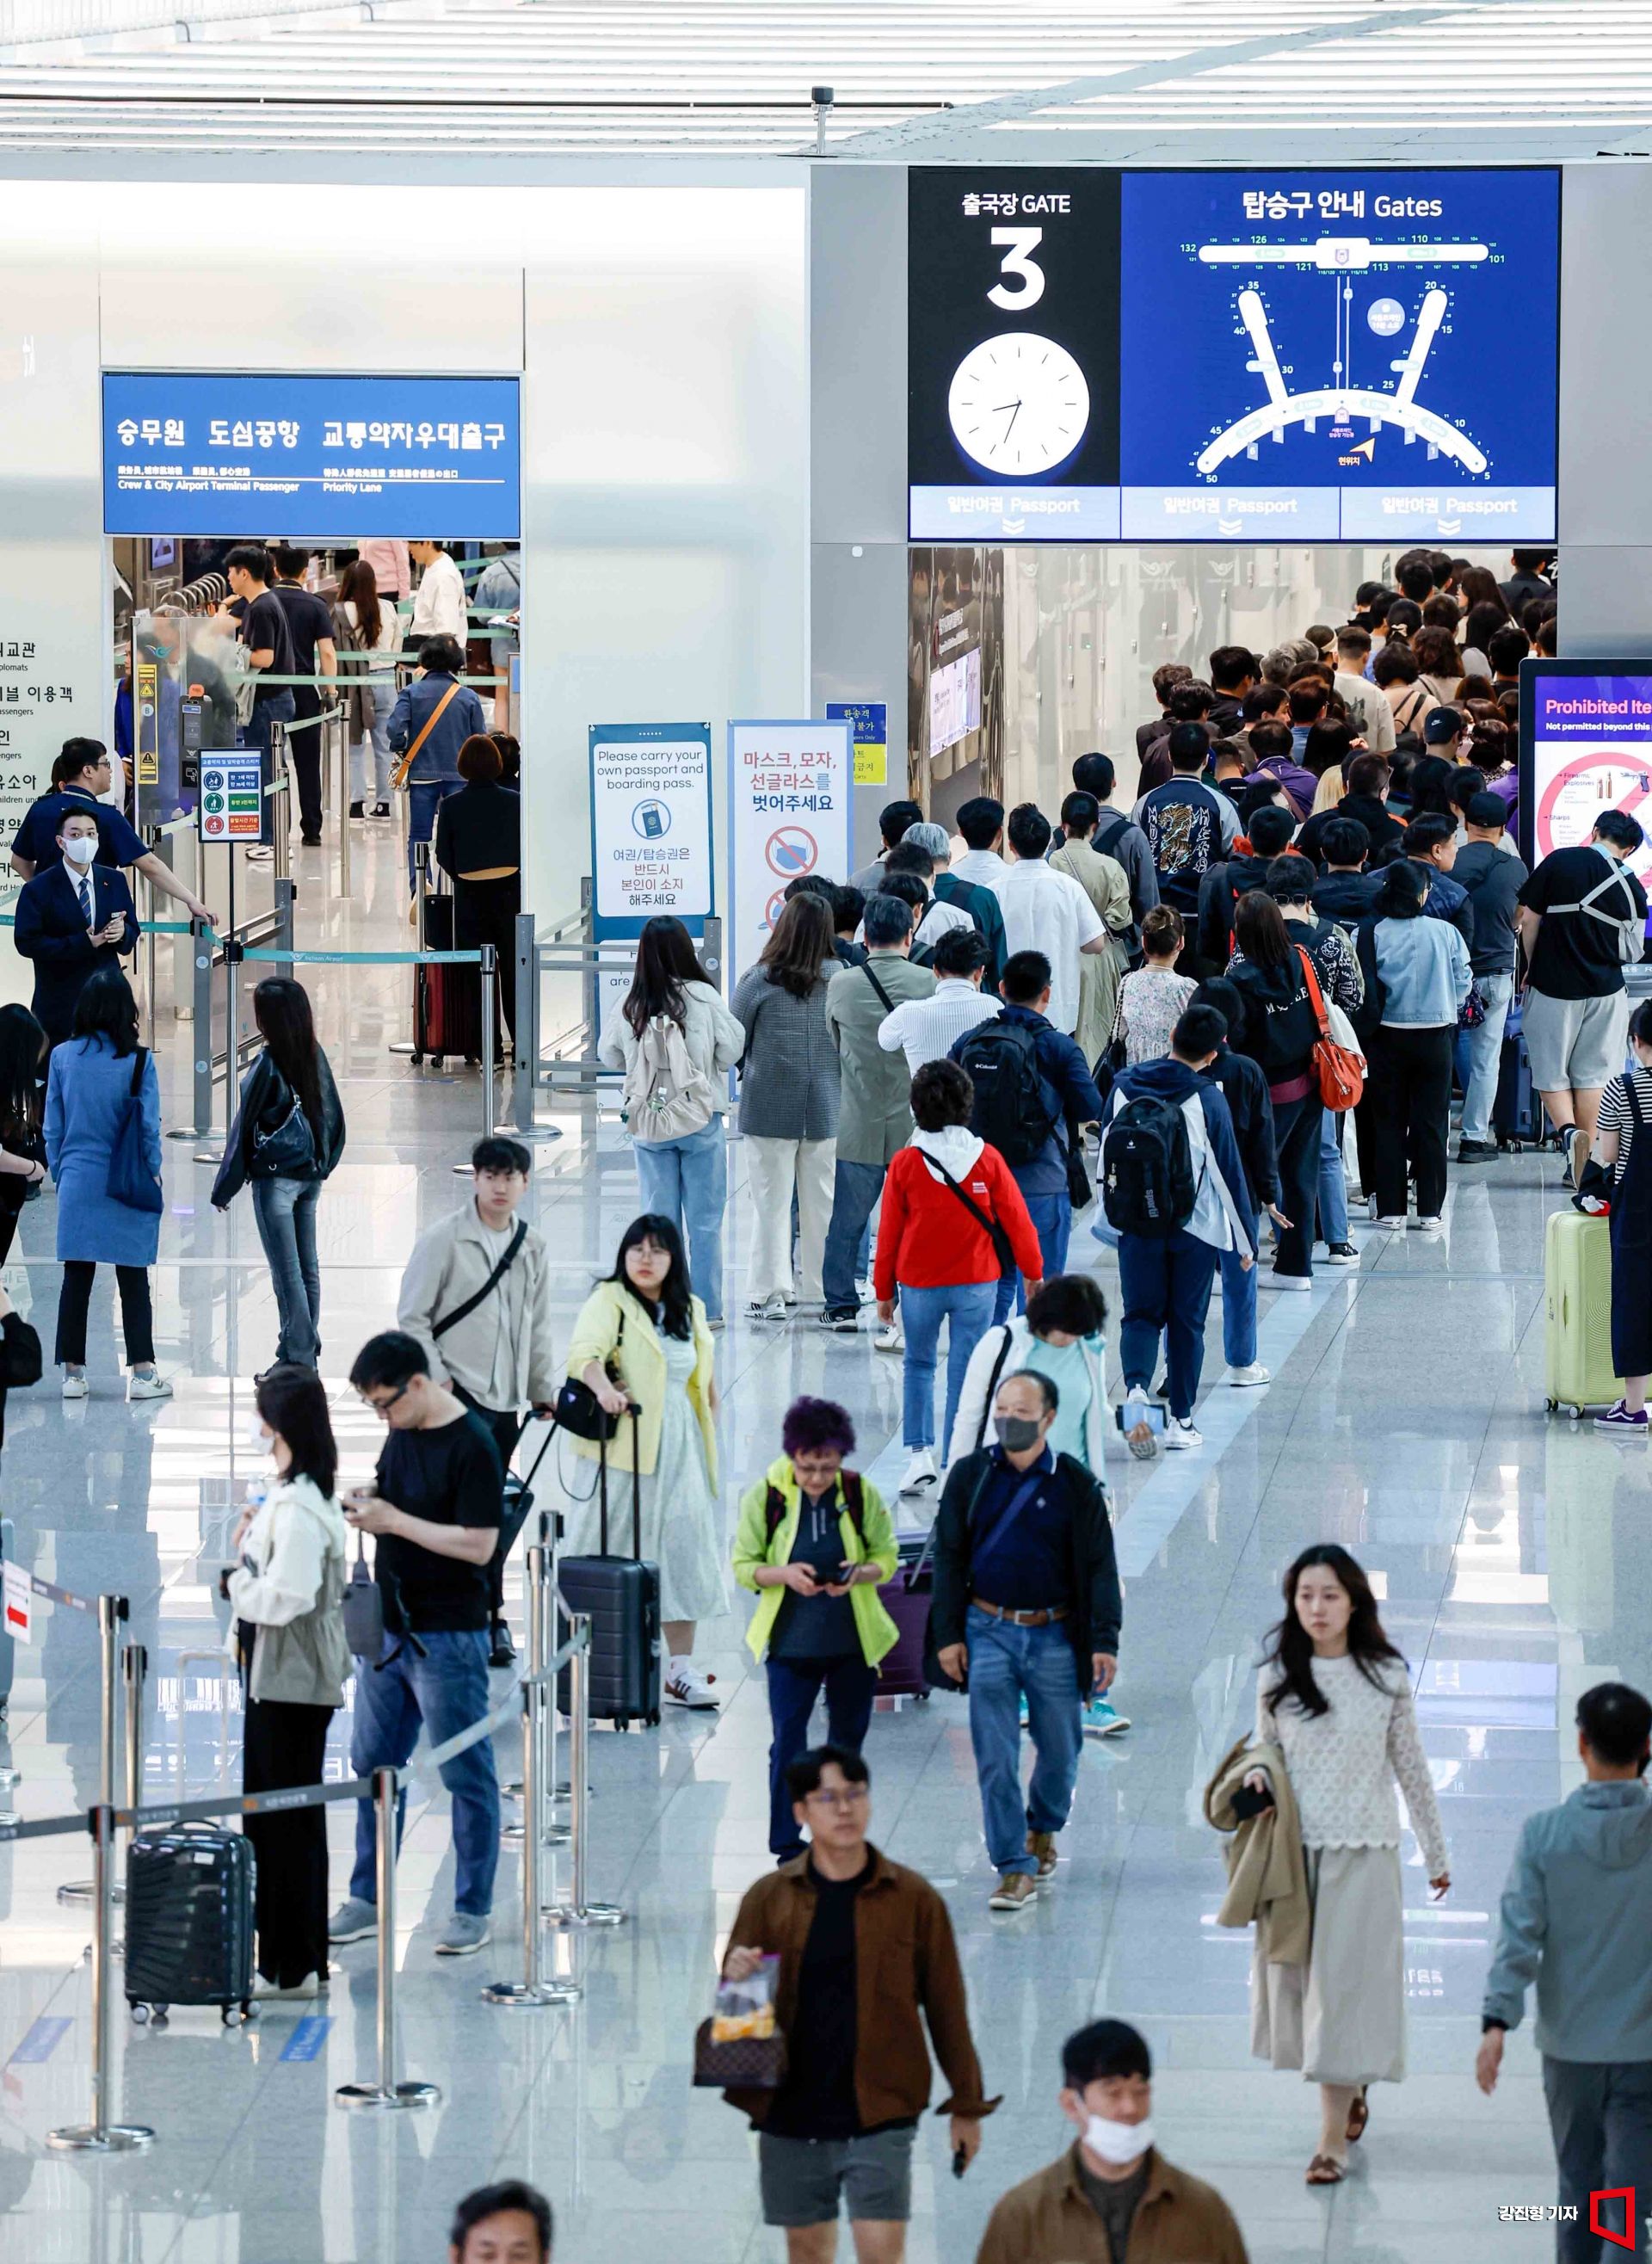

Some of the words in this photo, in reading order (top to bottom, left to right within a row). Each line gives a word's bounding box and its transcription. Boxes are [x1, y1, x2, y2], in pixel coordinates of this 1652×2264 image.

[962, 193, 1018, 216] 출국장
[1021, 194, 1070, 214] GATE
[1242, 190, 1314, 220] 탑승구
[1317, 189, 1365, 219] 안내
[1374, 195, 1443, 218] Gates
[1250, 235, 1267, 244] 126
[1411, 234, 1428, 244] 110
[1180, 244, 1197, 253] 132
[1489, 255, 1505, 263] 101
[986, 226, 1045, 311] 3
[1295, 262, 1311, 271] 121
[1372, 262, 1390, 272] 113
[1247, 281, 1260, 290] 35
[1441, 325, 1453, 334] 15
[1382, 379, 1395, 389] 25
[1454, 418, 1466, 428] 10
[117, 418, 185, 447] 승무원
[208, 420, 300, 448] 도심공항
[323, 422, 506, 450] 교통약자우대출구
[1338, 456, 1360, 466] 현위치
[1453, 460, 1459, 468] 1
[1205, 474, 1218, 484] 50
[1483, 471, 1491, 480] 5
[118, 480, 142, 490] Crew
[145, 481, 152, 490] &
[155, 480, 174, 491] City
[176, 481, 208, 492] Airport
[211, 481, 250, 491] Terminal
[253, 481, 299, 493] Passenger
[323, 483, 358, 494] Priority
[361, 483, 382, 493] Lane
[946, 496, 1003, 514] 일반여권
[1010, 497, 1081, 516] Passport
[1163, 497, 1220, 514] 일반여권
[1227, 497, 1298, 517] Passport
[1381, 497, 1439, 514] 일반여권
[1446, 497, 1518, 517] Passport
[0, 686, 19, 702] 널
[28, 686, 72, 703] 이용객
[1545, 700, 1628, 714] Prohibited
[844, 709, 870, 719] 환송객
[854, 722, 874, 731] 불가
[1562, 722, 1602, 732] permitted
[1603, 722, 1633, 732] beyond
[1634, 722, 1650, 731] this
[599, 751, 638, 761] Please
[641, 753, 672, 762] carry
[675, 752, 701, 762] your
[626, 765, 677, 777] passport
[681, 763, 703, 774] and
[854, 762, 874, 772] 금지
[607, 779, 659, 791] boarding
[663, 780, 694, 790] pass.
[750, 773, 830, 790] 선글라스를
[753, 794, 833, 812] 벗어주세요
[613, 848, 689, 861] 여권/탑승권은
[635, 864, 669, 875] 반드시
[622, 879, 656, 891] 본인이
[661, 879, 682, 890] 소지
[629, 893, 676, 905] 해주세요
